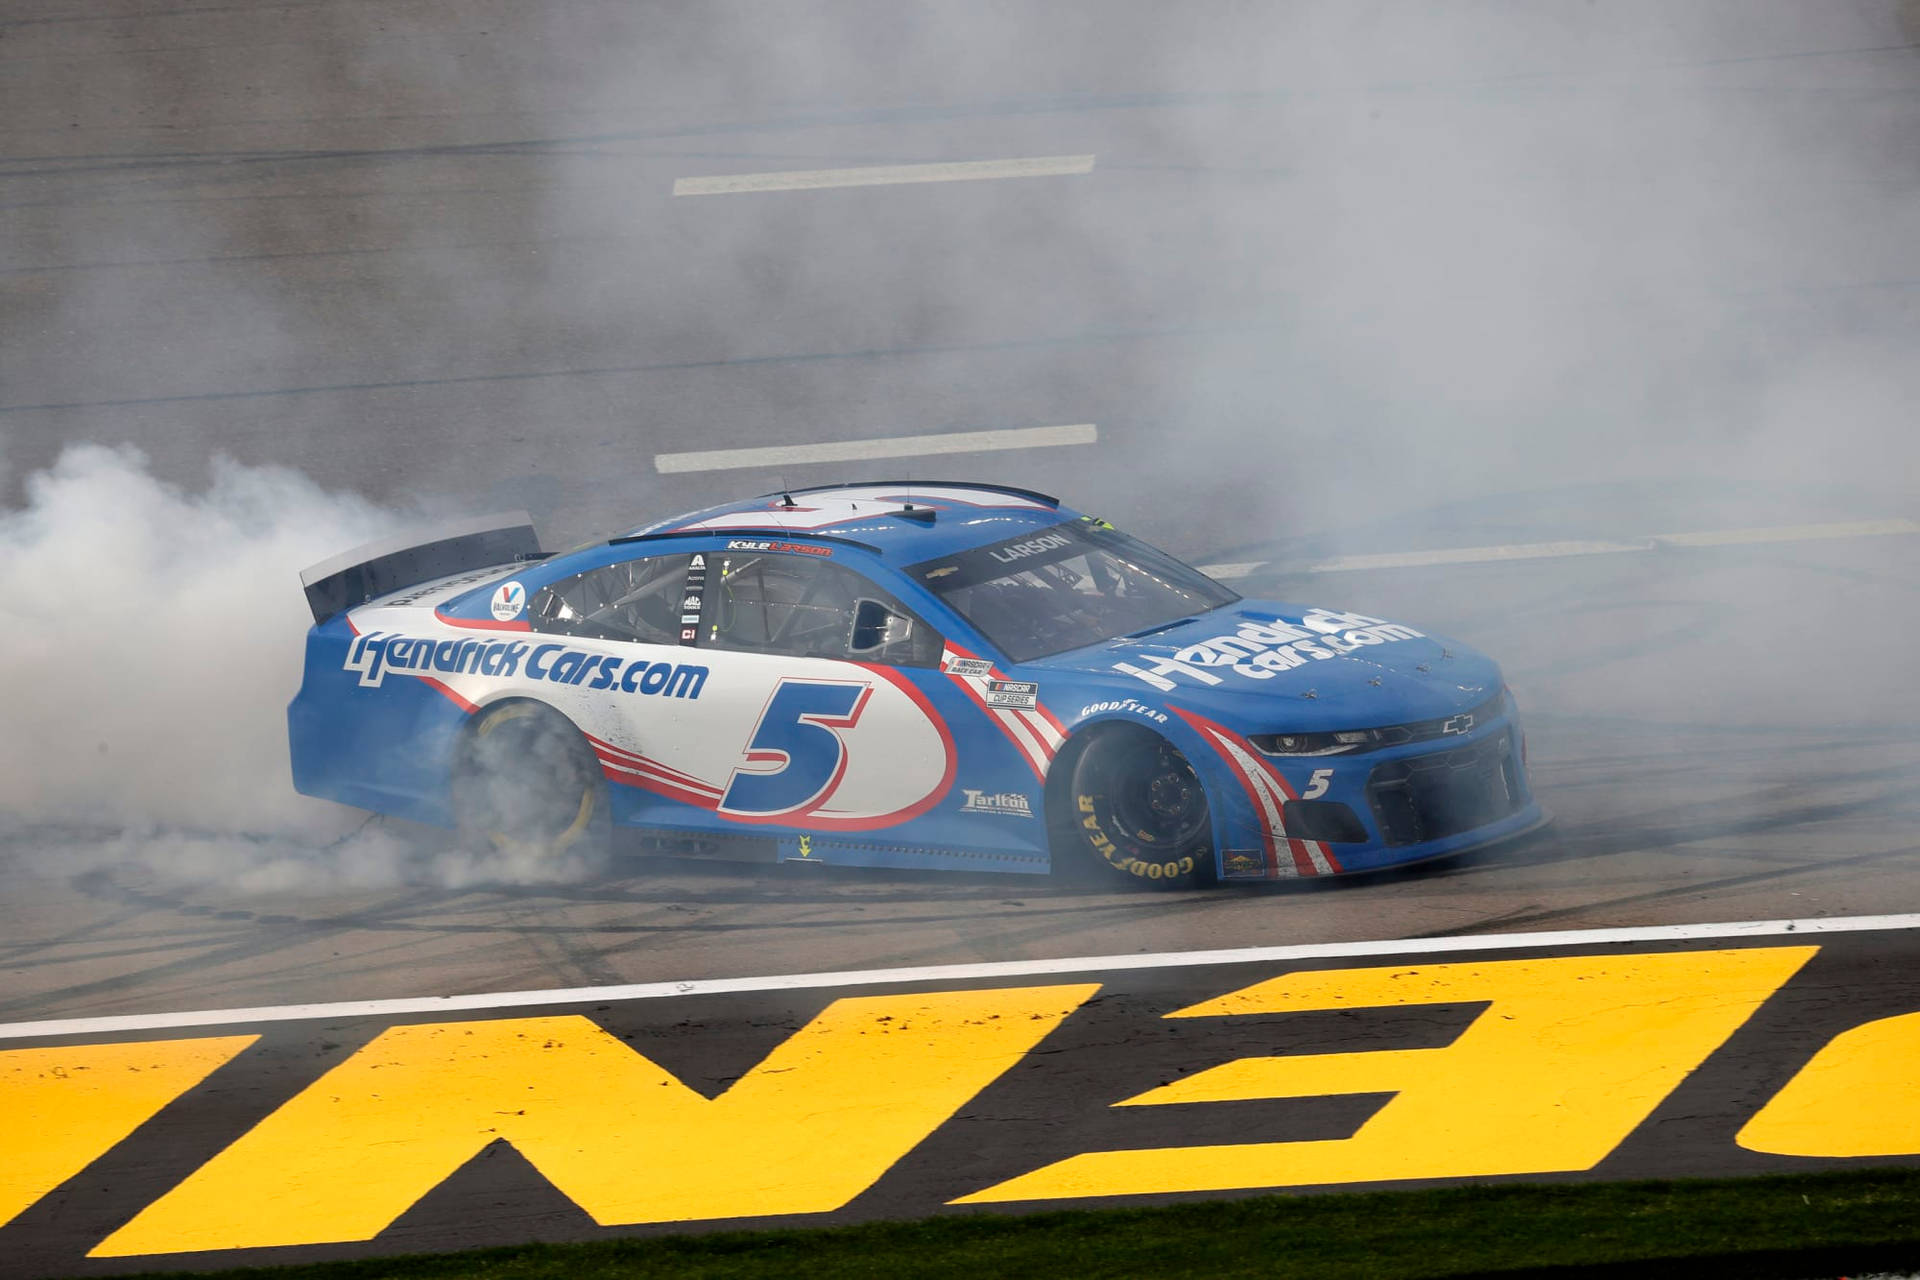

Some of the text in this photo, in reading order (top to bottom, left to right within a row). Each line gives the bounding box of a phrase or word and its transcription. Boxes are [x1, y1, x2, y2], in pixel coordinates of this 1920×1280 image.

[989, 533, 1072, 563] LARSON
[1112, 607, 1388, 692] Hendrck
[960, 660, 988, 669] NASCAR
[993, 694, 1030, 705] CUP SERIES
[1003, 683, 1031, 692] NASCAR
[1081, 699, 1169, 723] GOODYEAR
[717, 677, 874, 818] 5
[1302, 769, 1335, 800] 5
[962, 789, 1030, 810] Tarlton
[1078, 795, 1194, 879] GOODYEAR
